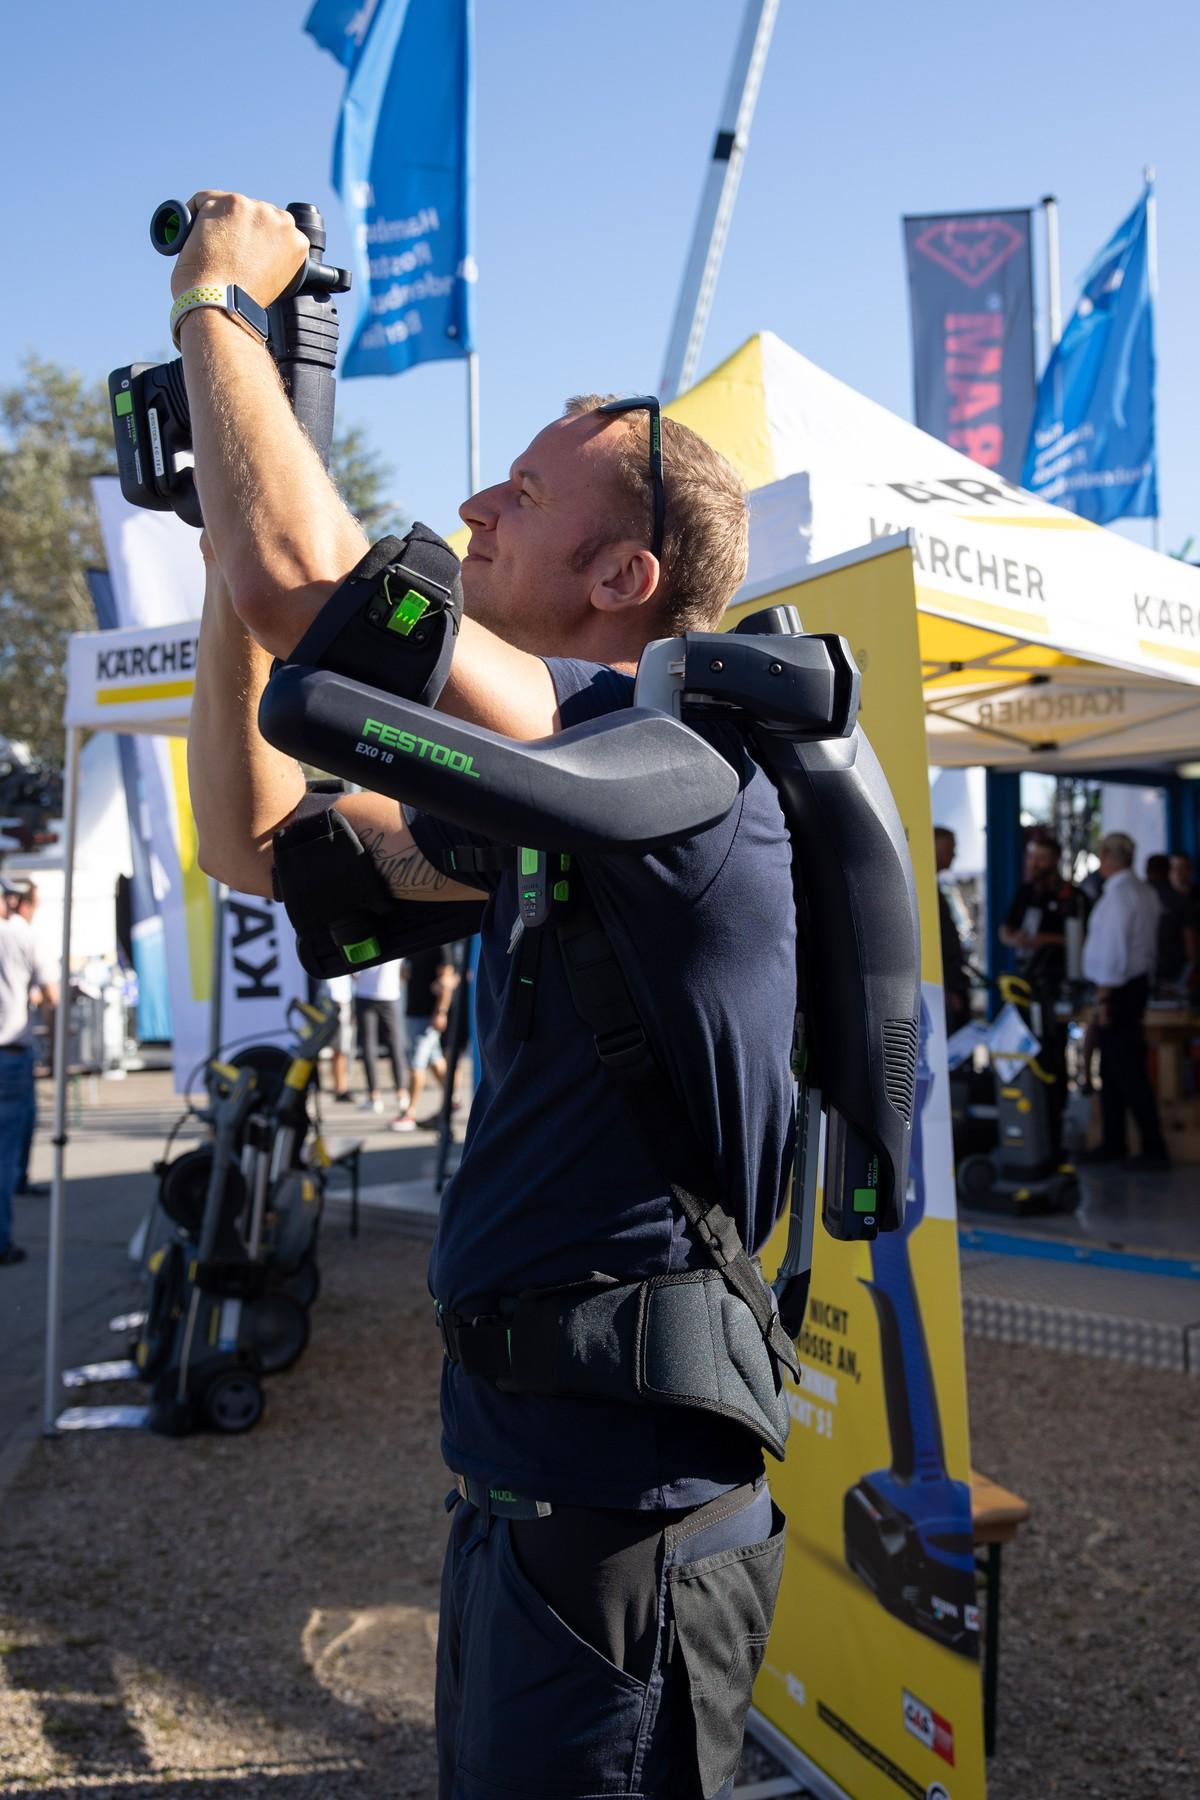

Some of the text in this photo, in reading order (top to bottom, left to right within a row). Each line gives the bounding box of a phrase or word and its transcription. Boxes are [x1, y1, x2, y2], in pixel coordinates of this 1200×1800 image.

[1134, 592, 1200, 638] KÄR
[96, 639, 199, 681] KÄRCHE
[362, 718, 480, 778] FESTOOL
[380, 752, 394, 764] 18
[229, 898, 281, 998] KÄ
[811, 1299, 848, 1334] NICHT
